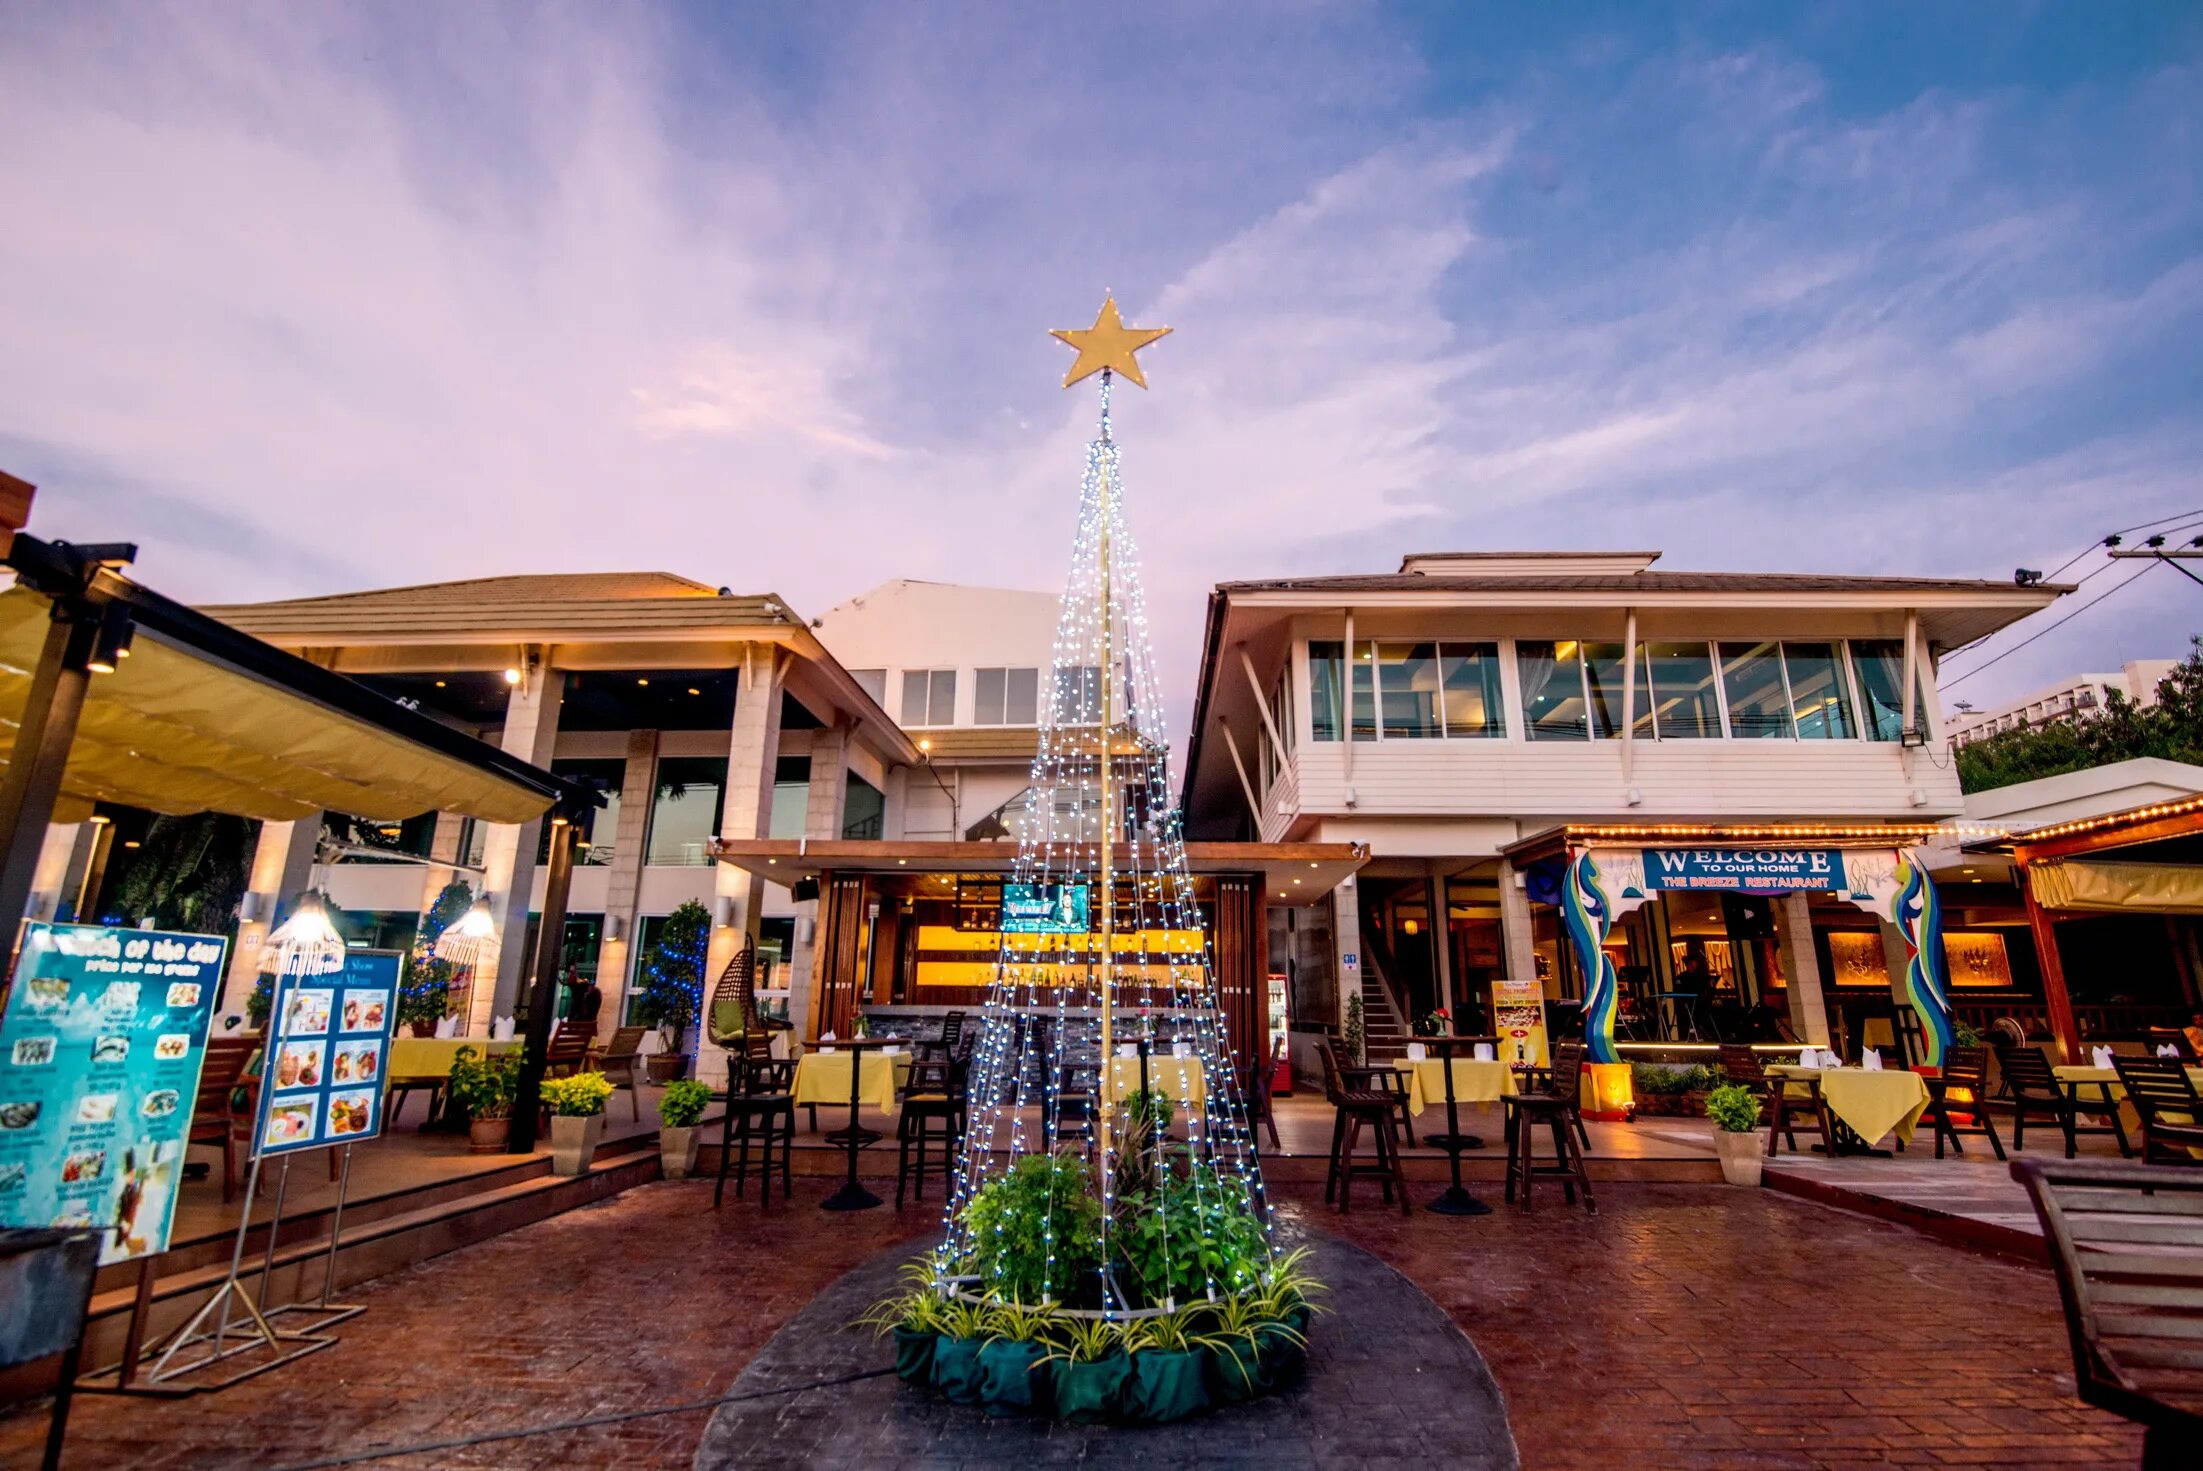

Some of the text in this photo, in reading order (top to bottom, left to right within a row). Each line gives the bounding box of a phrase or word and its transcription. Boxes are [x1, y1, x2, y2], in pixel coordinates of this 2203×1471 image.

[1655, 850, 1831, 873] WELCOME
[1702, 864, 1799, 873] TO OUR HOME
[1661, 876, 1830, 889] THE BREEZE RESTAURANT
